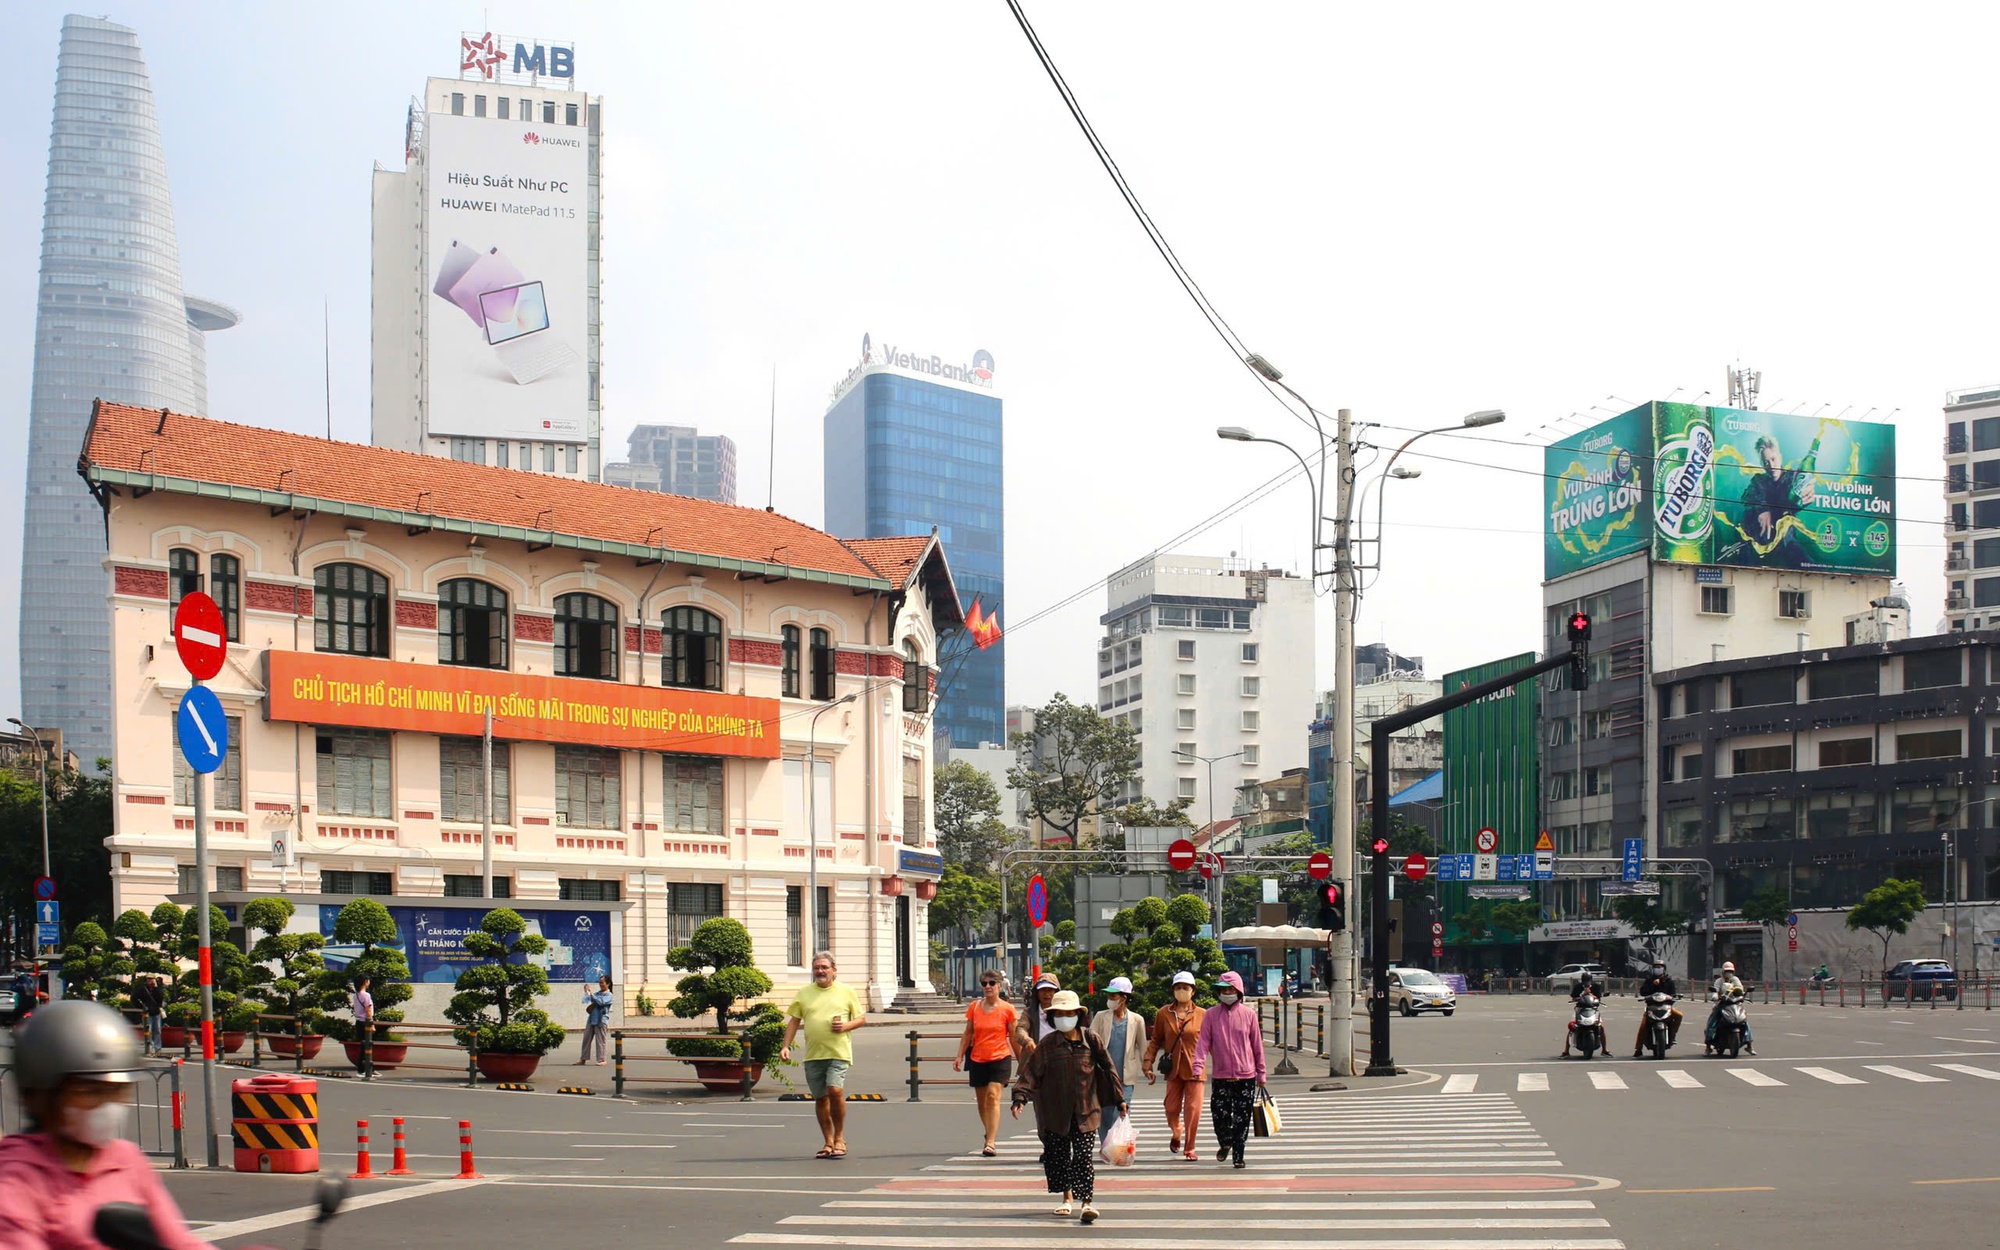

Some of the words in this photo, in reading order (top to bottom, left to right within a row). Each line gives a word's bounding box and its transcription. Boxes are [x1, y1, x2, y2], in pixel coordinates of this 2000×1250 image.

[512, 43, 574, 78] MB
[542, 137, 580, 148] HUAWEI
[448, 172, 479, 188] Hiệu
[483, 174, 514, 188] Suất
[518, 178, 547, 191] Như
[550, 181, 568, 194] PC
[441, 198, 497, 212] HUAWEI
[502, 203, 550, 216] MatePad
[553, 207, 575, 219] 11.5
[883, 343, 974, 384] VietinBank
[1584, 432, 1613, 452] TUBORG
[1563, 478, 1582, 499] VUI
[1584, 467, 1613, 490] ĐỈNH
[1660, 449, 1707, 529] TUBORG
[1826, 481, 1844, 492] VUI
[1847, 481, 1873, 495] ĐỈNH
[1551, 495, 1606, 533] TRÚNG
[1608, 480, 1642, 513] LỚN
[1698, 495, 1710, 522] GREEN
[1814, 492, 1862, 510] TRÚNG
[1865, 496, 1891, 514] LỚN
[1826, 524, 1832, 534] 3
[1849, 537, 1857, 547] X
[293, 673, 324, 701] CHỦ
[327, 680, 361, 706] TỊCH
[365, 680, 385, 706] HỒ
[388, 683, 412, 708] CHÍ
[416, 690, 453, 712] MINH
[456, 690, 471, 714] VĨ
[500, 692, 535, 718] SỐNG
[539, 698, 563, 720] MÃI
[567, 702, 608, 725] TRONG
[612, 706, 629, 731] SỰ
[632, 708, 676, 733] NGHIỆP
[679, 708, 703, 733] CỦA
[706, 714, 746, 736] CHÚNG
[748, 719, 764, 738] TA
[429, 938, 457, 947] THÁNG
